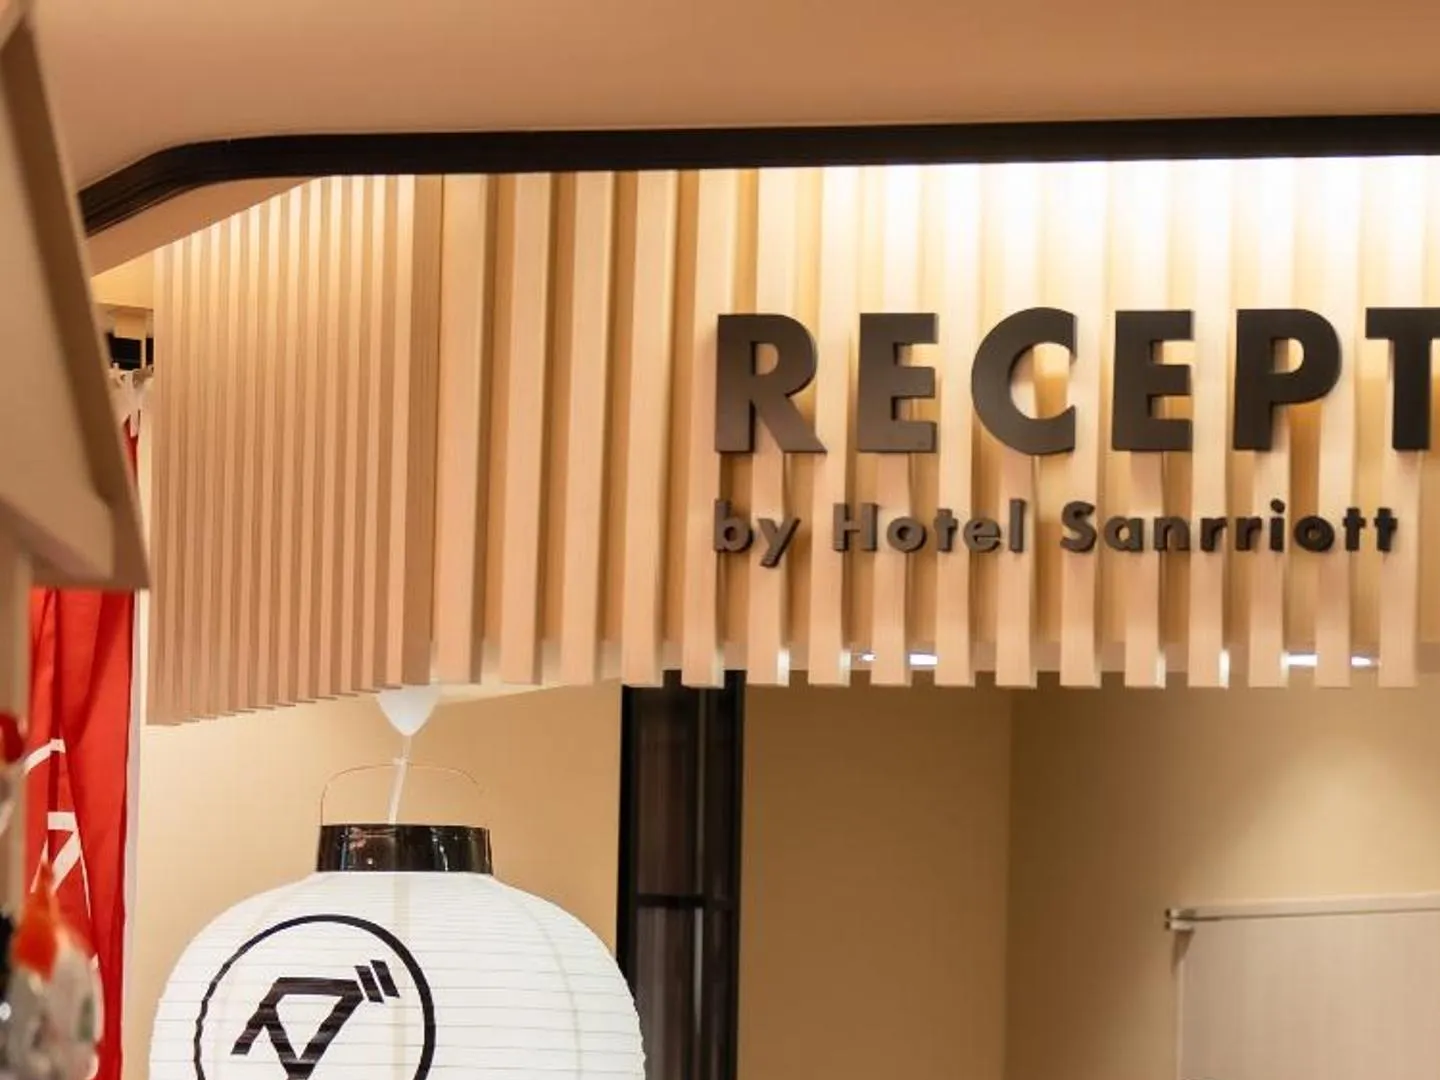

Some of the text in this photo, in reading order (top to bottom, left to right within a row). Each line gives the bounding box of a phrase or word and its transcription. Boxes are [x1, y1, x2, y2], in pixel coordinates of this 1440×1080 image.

[712, 498, 1399, 567] by Hotel Sanrriott
